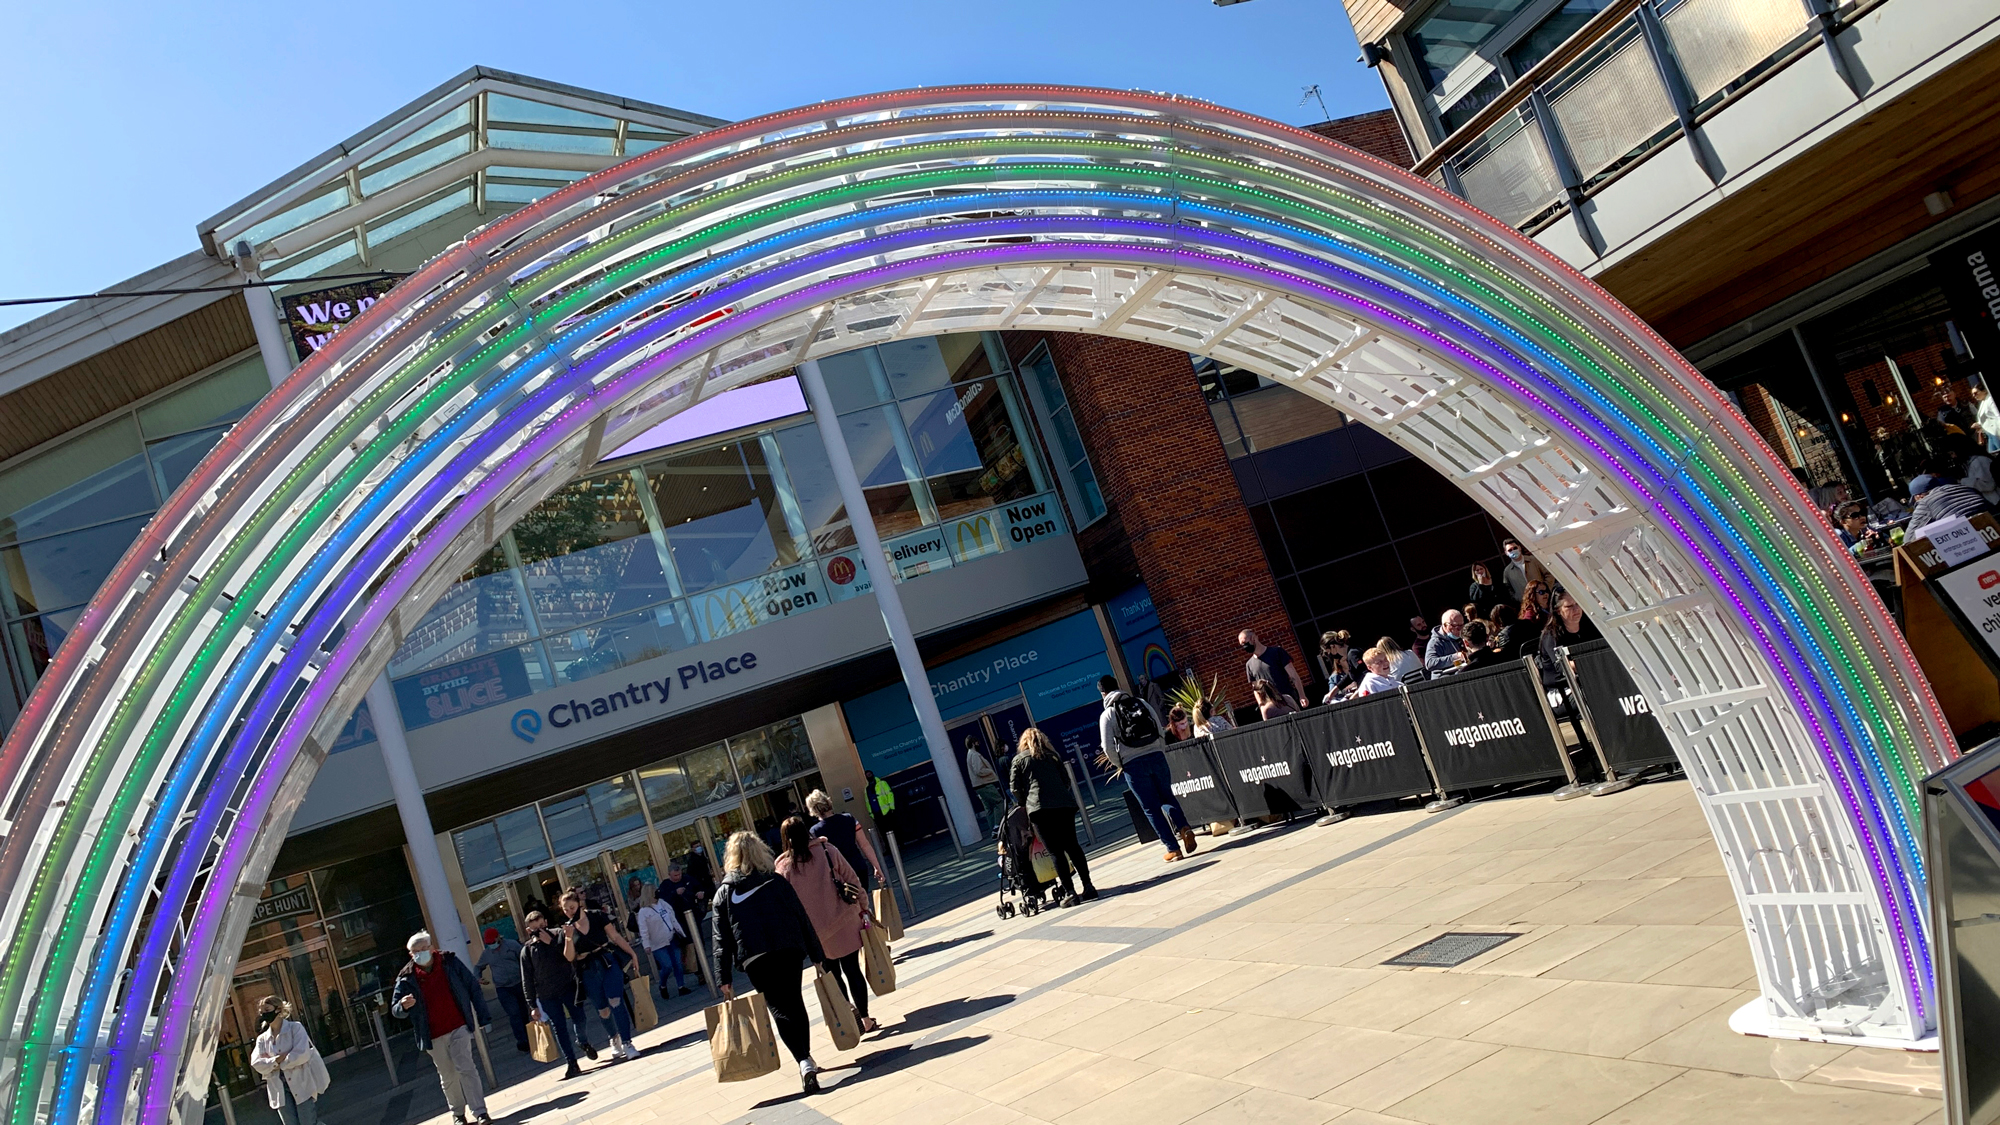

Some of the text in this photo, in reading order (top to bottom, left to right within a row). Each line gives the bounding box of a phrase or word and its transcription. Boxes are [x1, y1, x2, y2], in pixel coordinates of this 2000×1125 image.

[296, 300, 351, 325] We
[1006, 502, 1045, 524] Now
[1010, 520, 1056, 543] Open
[1935, 527, 1970, 545] EXIT ONLY
[762, 572, 806, 596] Now
[855, 580, 872, 592] avai
[1982, 574, 1998, 584] new
[766, 590, 818, 616] Open
[1121, 596, 1152, 618] Thank you
[422, 675, 469, 696] BY THE
[930, 650, 1038, 698] Chantry Place
[1038, 686, 1060, 697] Welcome
[1066, 677, 1087, 687] Chantry
[1086, 671, 1100, 679] Place
[426, 677, 507, 720] SLICE
[548, 651, 757, 728] Chantry Place
[1051, 691, 1065, 699] Good
[1445, 717, 1526, 748] wagamama
[872, 748, 893, 758] Welcome
[899, 739, 918, 748] Chantry
[1326, 740, 1395, 768] wagamama
[1239, 760, 1291, 785] wagamama
[1171, 775, 1215, 798] wagamama
[274, 892, 306, 912] HUNT
